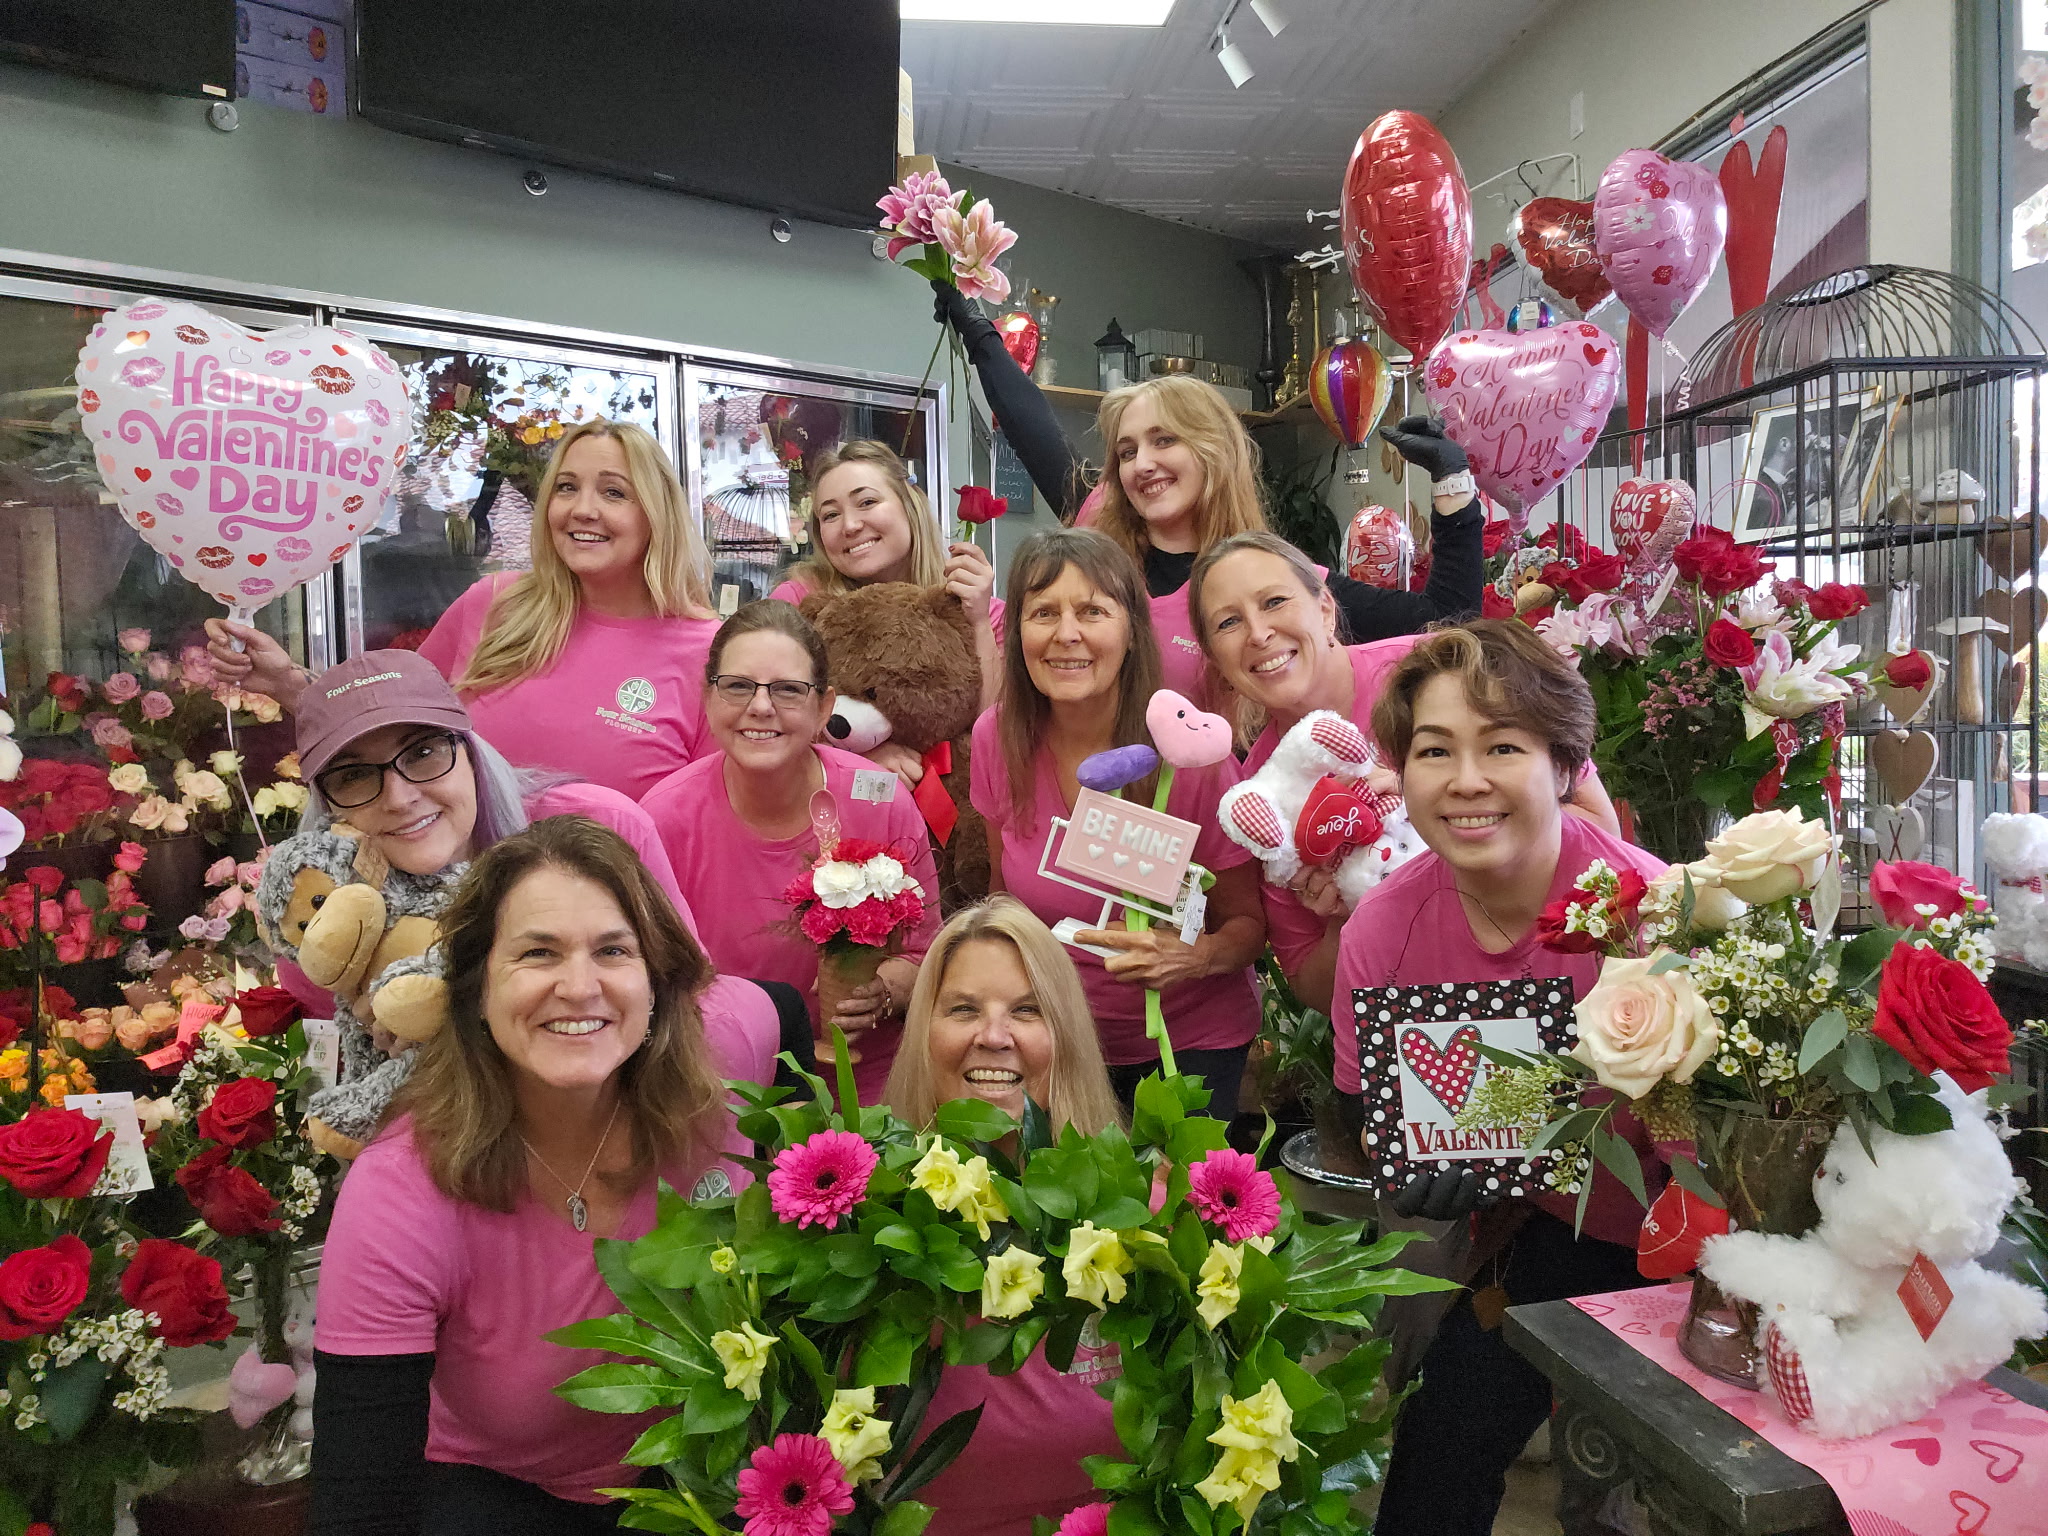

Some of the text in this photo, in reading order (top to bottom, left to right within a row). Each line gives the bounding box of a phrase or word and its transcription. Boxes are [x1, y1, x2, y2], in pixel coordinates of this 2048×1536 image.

[1539, 229, 1598, 250] Valent
[1557, 211, 1596, 233] Hap
[1566, 248, 1605, 276] Da
[172, 351, 303, 414] Happy
[1461, 343, 1585, 388] Happy
[1448, 381, 1588, 432] Valentine's
[117, 406, 385, 487] Valentine's
[1484, 422, 1560, 480] Day
[208, 465, 319, 542] Day
[1614, 511, 1645, 530] YOU
[326, 672, 402, 699] Four Seasons
[595, 706, 656, 733] Four Seasons
[1082, 808, 1184, 865] BE MINE
[1316, 806, 1363, 837] Love
